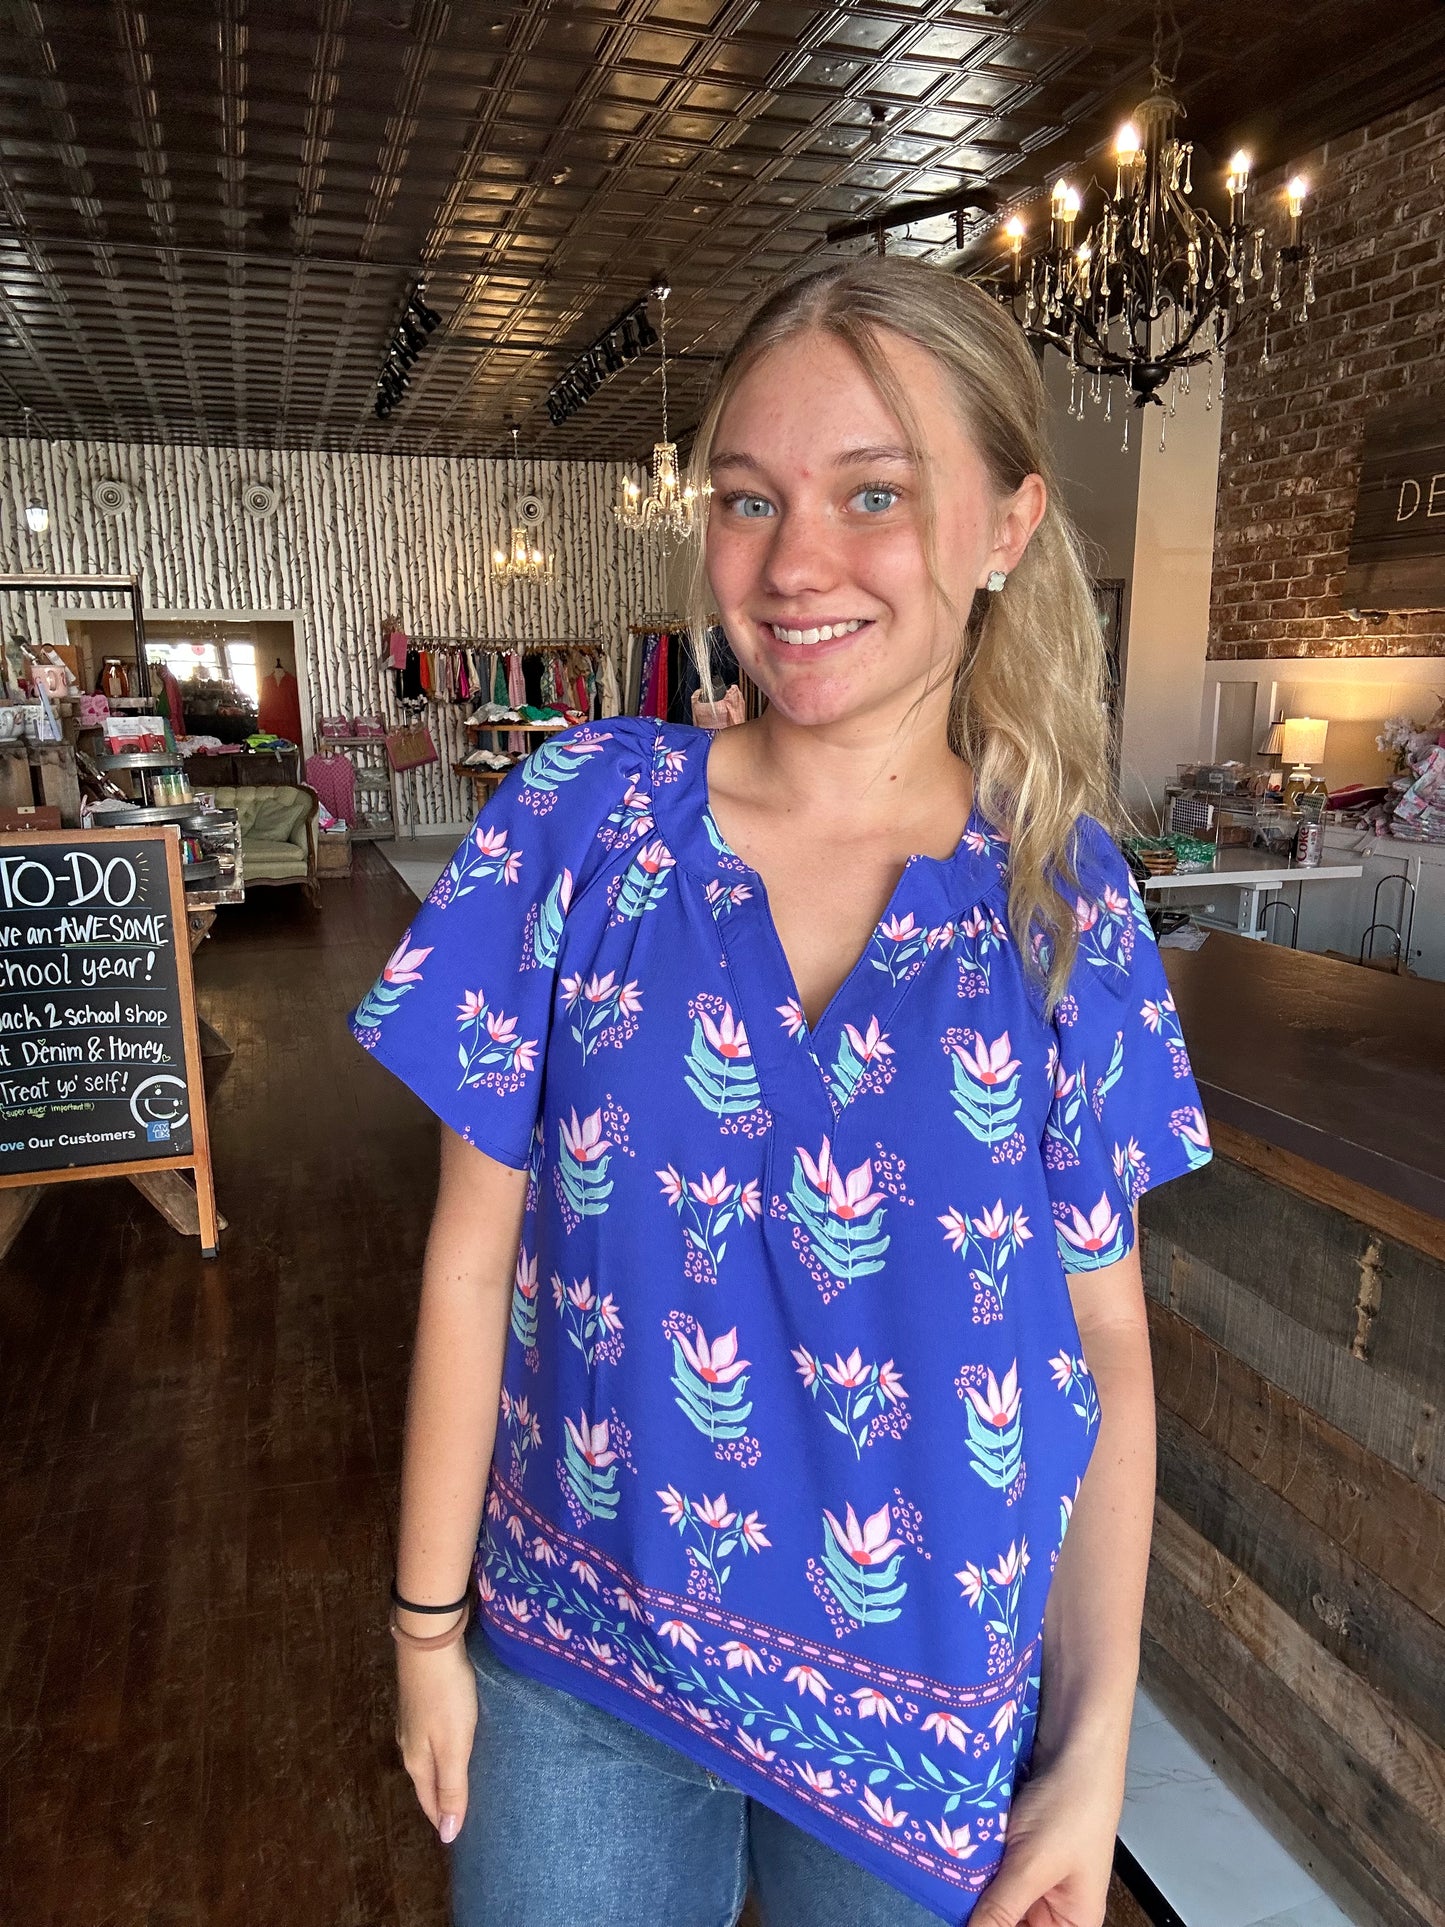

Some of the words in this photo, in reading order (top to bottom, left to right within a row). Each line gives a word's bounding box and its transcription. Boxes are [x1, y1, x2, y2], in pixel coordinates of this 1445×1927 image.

[1297, 827, 1310, 862] Coke
[0, 852, 137, 908] TO-DO
[0, 926, 22, 947] ve
[27, 926, 53, 945] an
[54, 914, 169, 945] AWESOME
[81, 951, 156, 987] year!
[0, 1003, 42, 1032] ack
[44, 1002, 62, 1028] 2
[64, 1000, 120, 1026] school
[125, 1004, 168, 1026] shop
[0, 1044, 11, 1066] t
[21, 1041, 83, 1067] Denim
[87, 1036, 105, 1062] &
[109, 1035, 164, 1063] Honey
[0, 1076, 50, 1105] Treat
[84, 1070, 129, 1094] self!
[28, 1137, 55, 1149] Our
[58, 1129, 136, 1147] Customers
